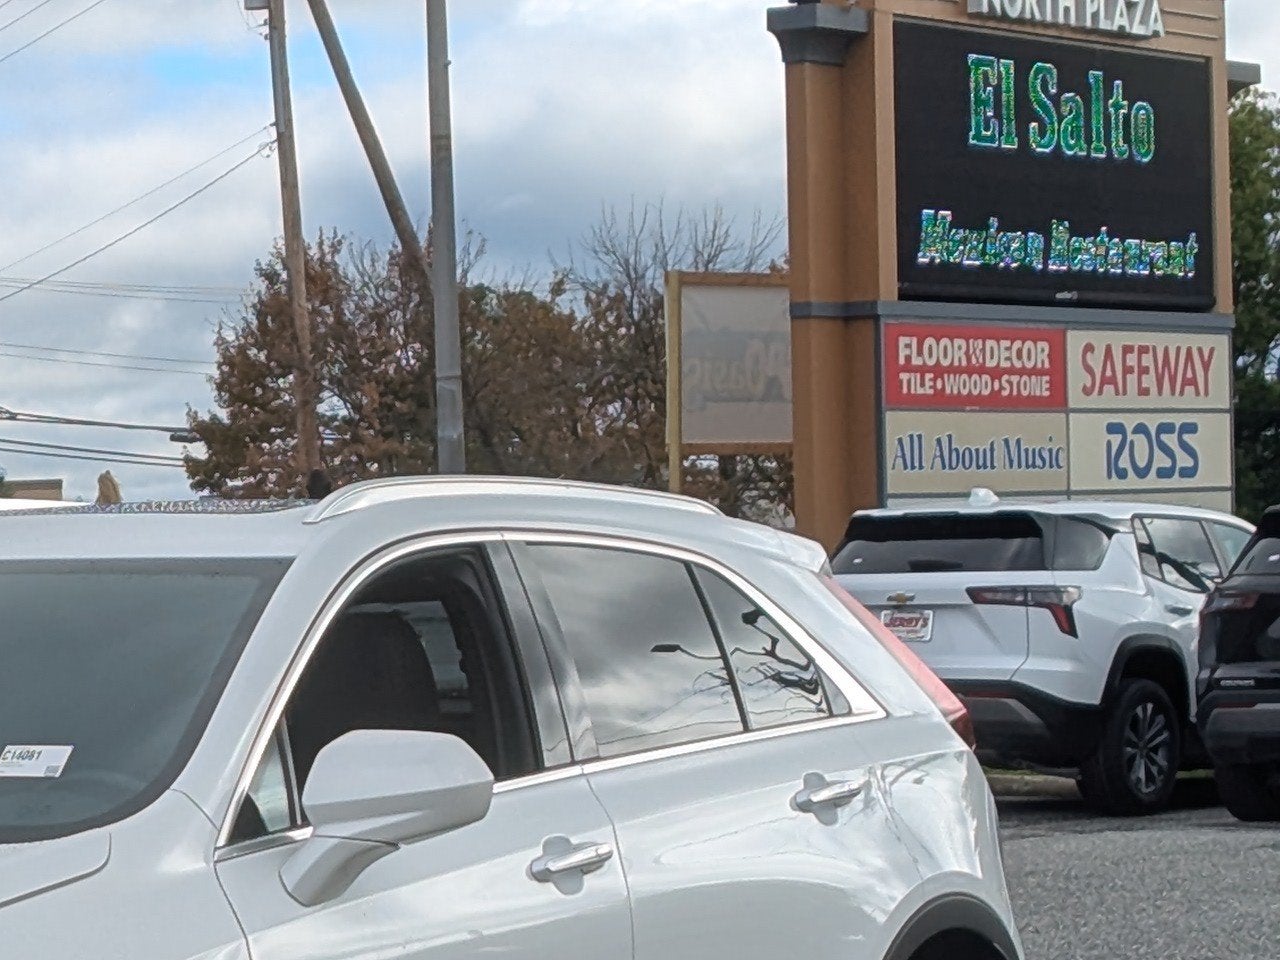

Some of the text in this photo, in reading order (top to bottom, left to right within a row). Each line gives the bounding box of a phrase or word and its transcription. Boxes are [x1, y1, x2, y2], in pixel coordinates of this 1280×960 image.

[1086, 0, 1165, 37] PLAZA
[968, 54, 1155, 163] El Salto
[898, 336, 967, 367] FLOOR
[986, 339, 1051, 369] DECOR
[1081, 342, 1216, 397] SAFEWAY
[899, 373, 1051, 397] TILE WOOD STONE
[891, 433, 1065, 471] All About Music
[1106, 422, 1200, 480] ROSS
